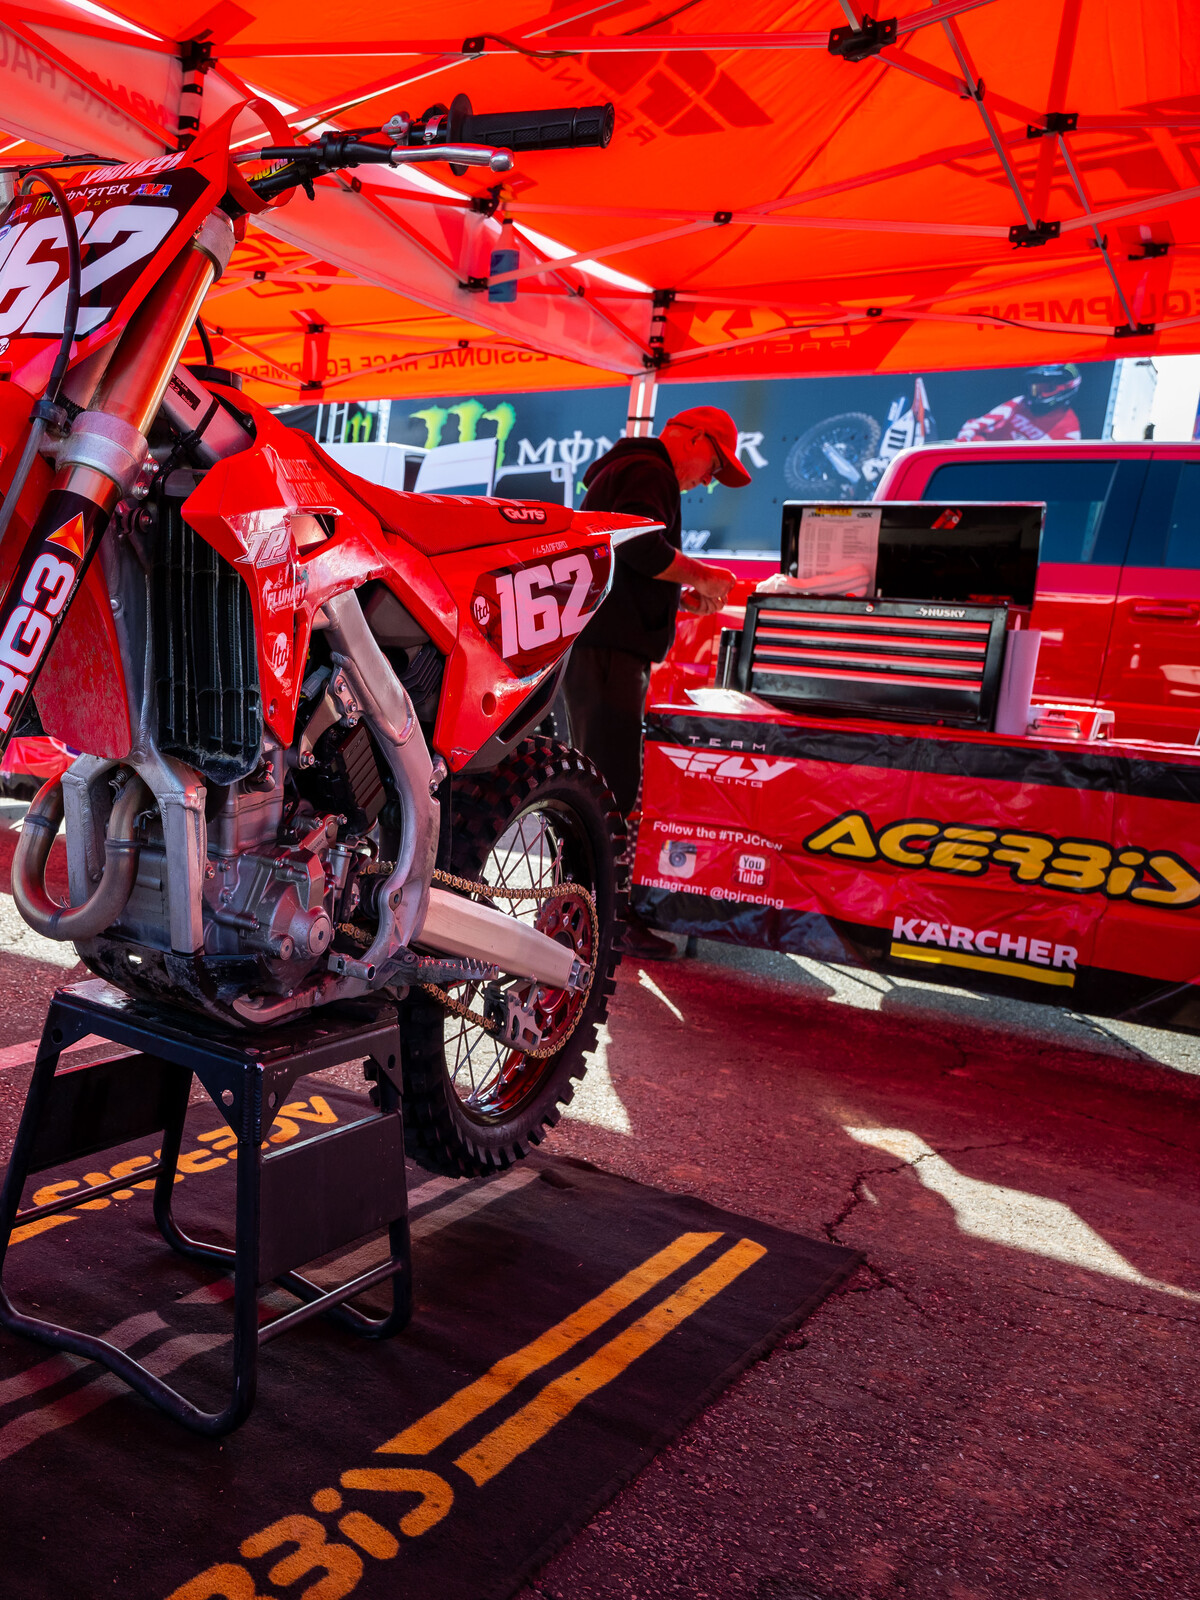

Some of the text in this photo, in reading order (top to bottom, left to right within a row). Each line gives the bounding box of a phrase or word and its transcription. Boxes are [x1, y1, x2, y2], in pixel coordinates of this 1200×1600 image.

[129, 183, 172, 197] AMA
[518, 430, 768, 475] MONR
[502, 507, 546, 521] GUTS
[246, 527, 293, 563] TPJ
[495, 553, 597, 660] 162
[927, 608, 966, 618] HUSKY
[688, 735, 766, 751] TEAM
[657, 746, 798, 781] FLY
[684, 771, 763, 788] RACING
[653, 821, 783, 851] Follow the #TPJCrew
[743, 857, 762, 870] You
[738, 868, 764, 886] Tube
[641, 875, 784, 909] Instagram: @tpjracing
[892, 916, 1078, 969] KÄRCHER
